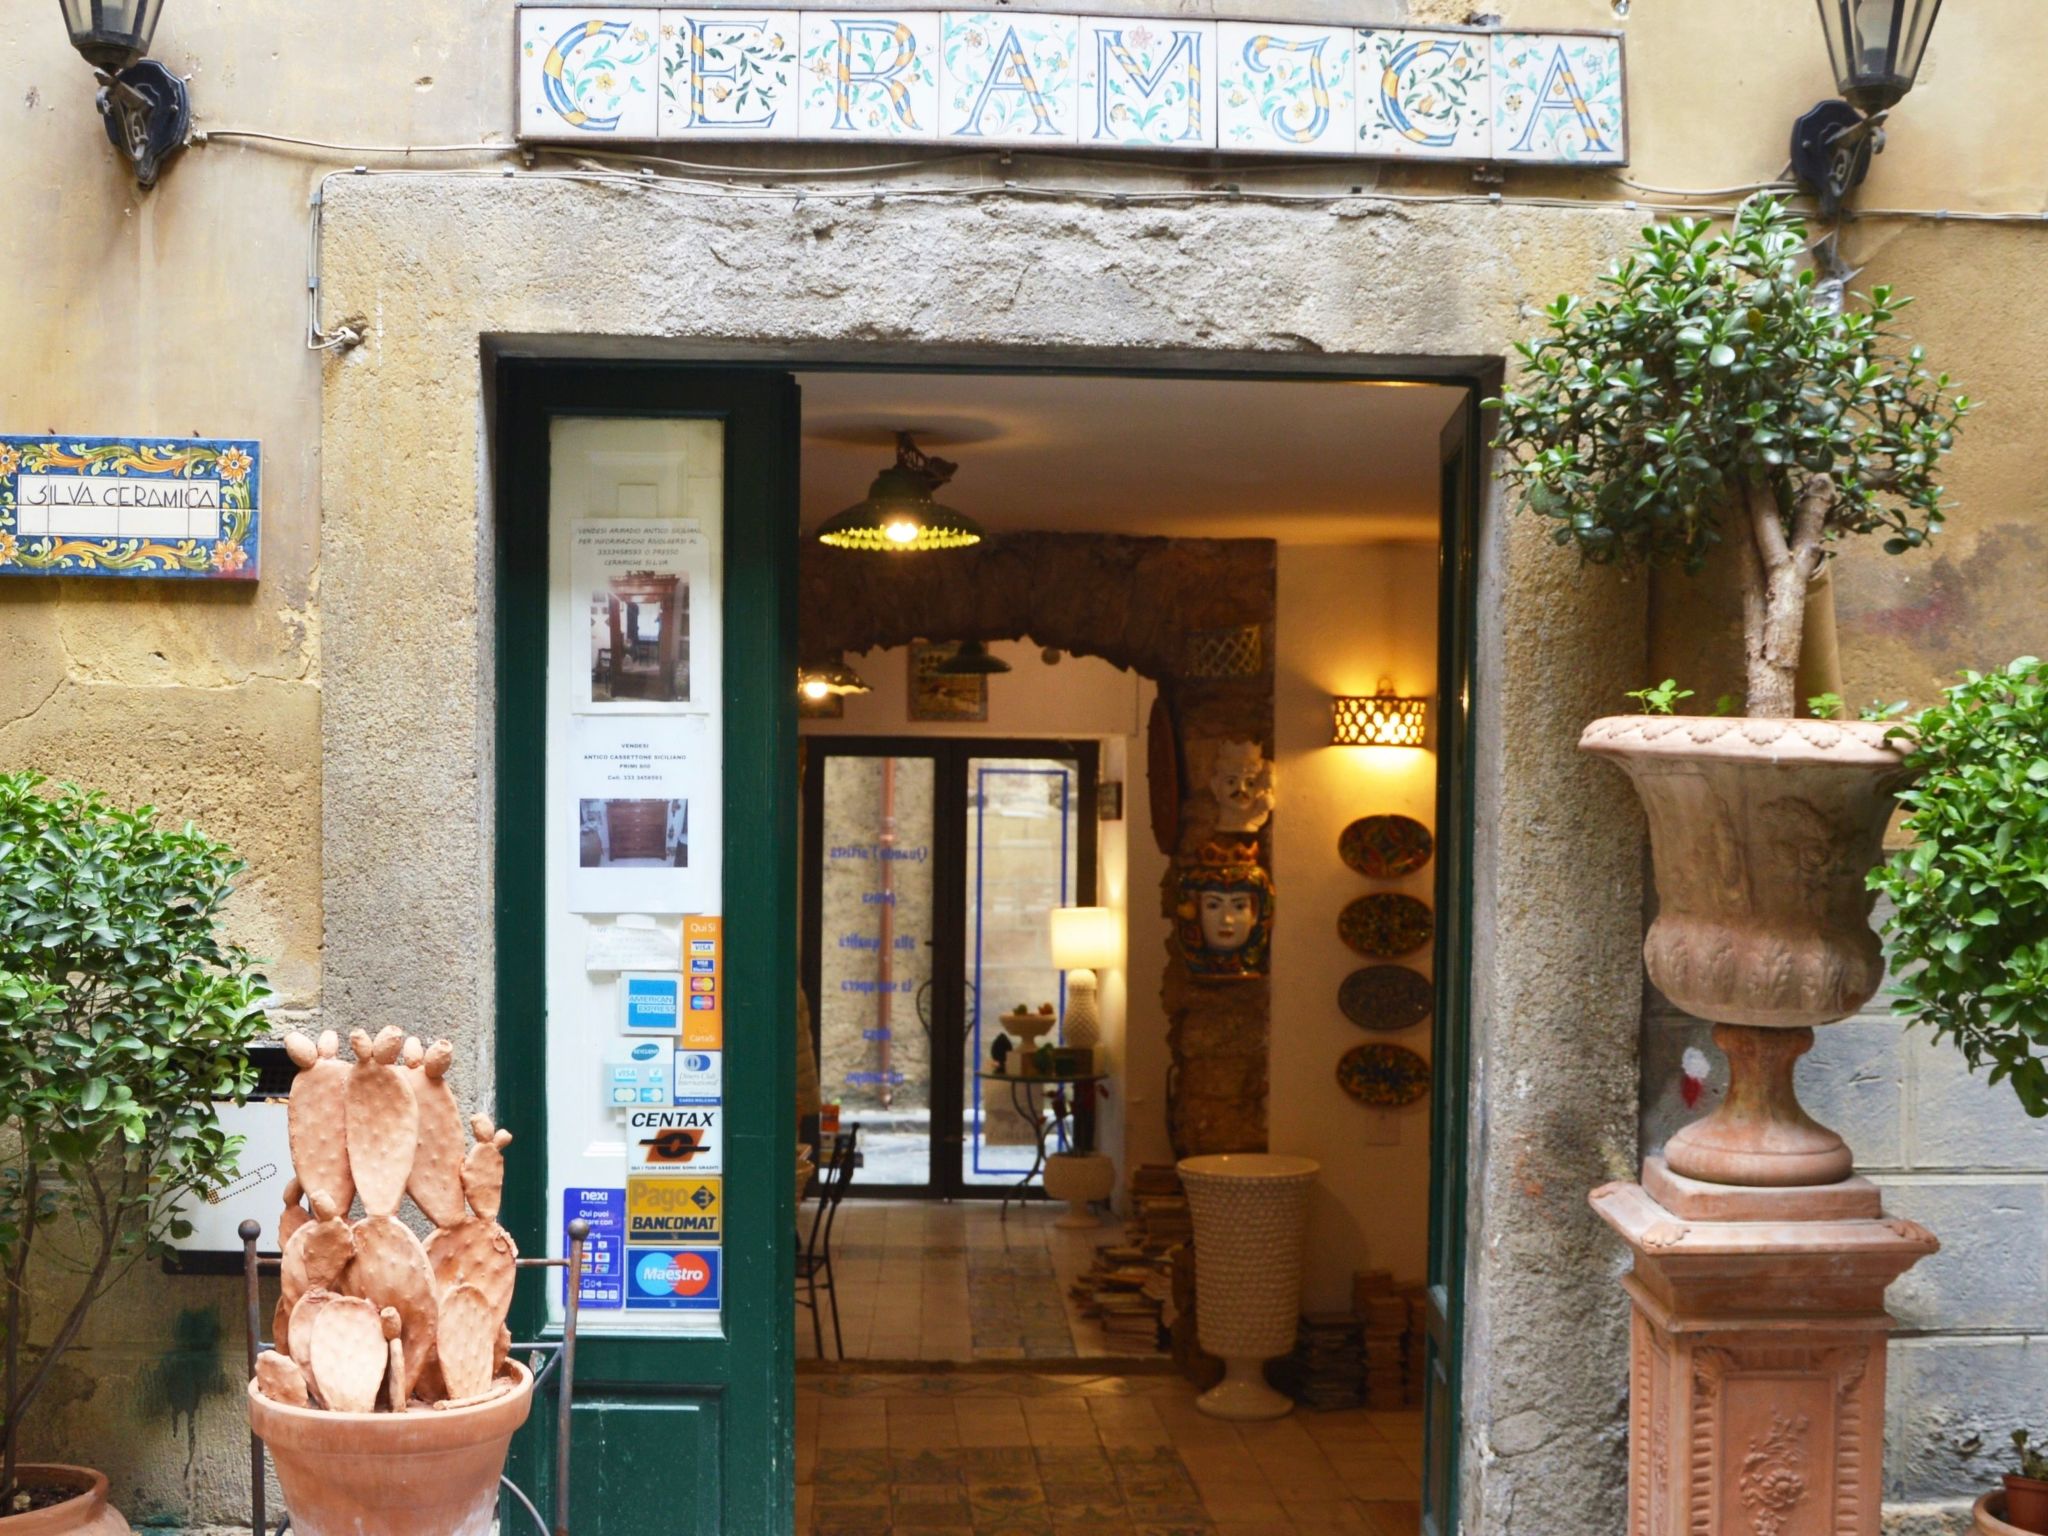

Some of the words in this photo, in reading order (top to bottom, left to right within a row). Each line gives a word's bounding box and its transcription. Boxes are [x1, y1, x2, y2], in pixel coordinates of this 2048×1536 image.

[543, 20, 1612, 151] CERAMICA
[26, 481, 95, 506] SILVA
[103, 485, 216, 509] CERAMICA
[690, 922, 707, 933] Qui
[695, 943, 711, 951] VISA
[629, 995, 674, 1004] AMERICAN
[638, 1005, 676, 1013] EXPRESS
[632, 1112, 715, 1127] CENTAX
[581, 1191, 608, 1201] nexi
[633, 1182, 688, 1211] Pago
[579, 1210, 592, 1218] Qui
[593, 1210, 609, 1218] puoi
[632, 1217, 717, 1230] BANCOMAT
[643, 1267, 704, 1280] Maestro
